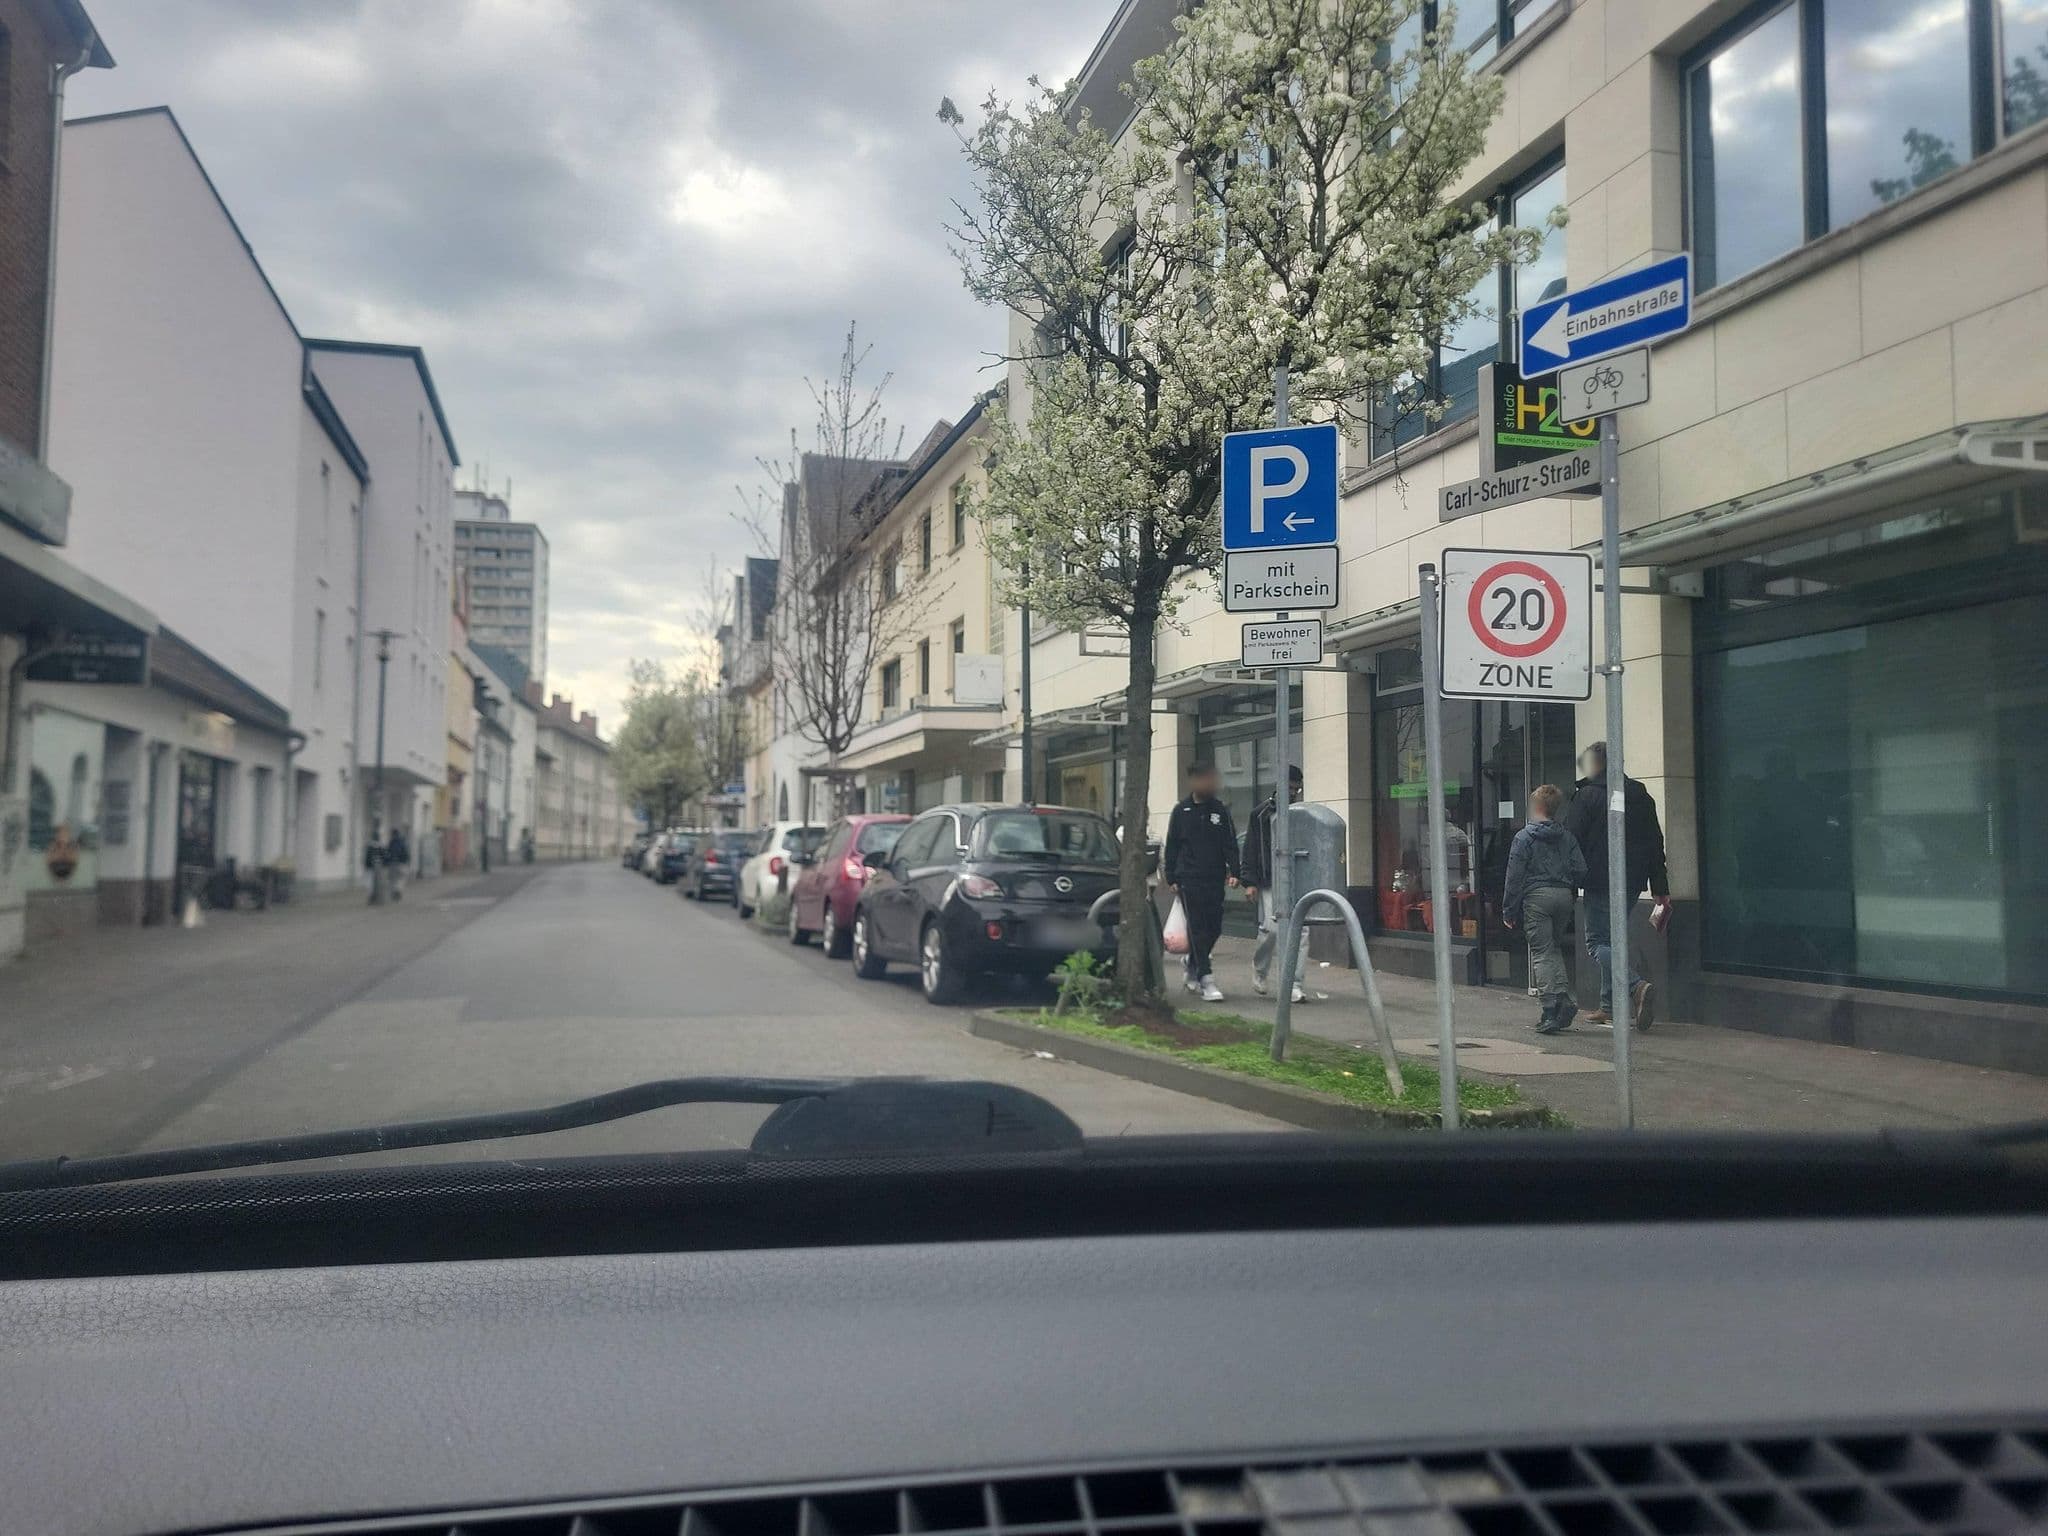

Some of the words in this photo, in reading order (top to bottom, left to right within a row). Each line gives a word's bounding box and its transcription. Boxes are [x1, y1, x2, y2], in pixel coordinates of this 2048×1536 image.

[1566, 289, 1679, 337] Einbahnstraße
[1504, 384, 1515, 429] studio
[1250, 444, 1310, 533] P
[1445, 456, 1591, 511] Carl-Schurz-Straße
[1267, 561, 1295, 577] mit
[1233, 580, 1329, 599] Parkschein
[1491, 587, 1545, 631] 20
[1250, 628, 1312, 640] Bewohner
[1271, 647, 1292, 660] frei
[1479, 663, 1553, 688] ZONE
